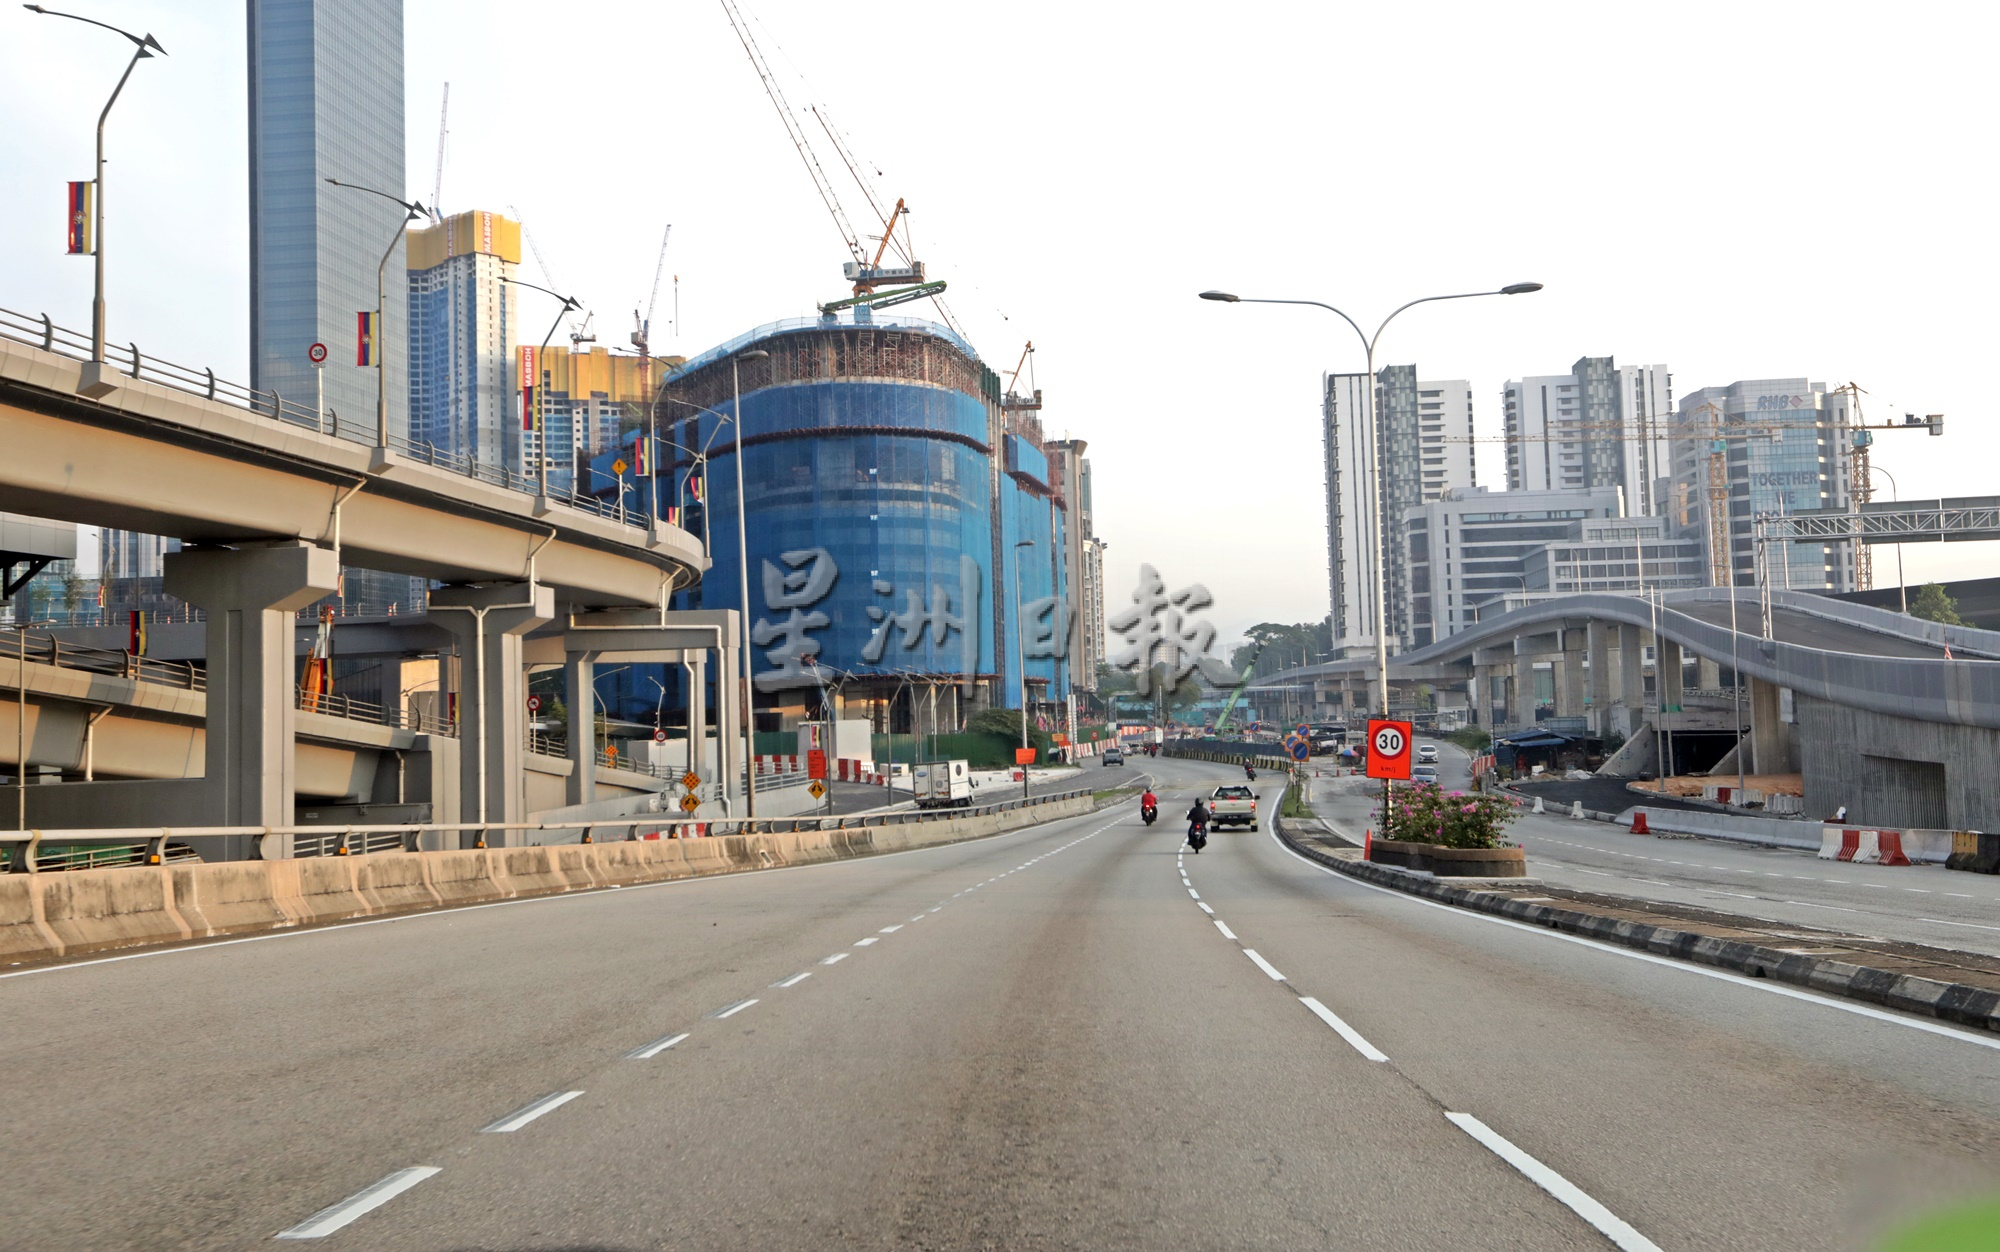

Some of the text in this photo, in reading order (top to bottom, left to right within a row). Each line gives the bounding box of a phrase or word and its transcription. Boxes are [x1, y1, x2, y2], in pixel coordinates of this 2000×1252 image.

[483, 212, 492, 253] MASBOH
[1757, 395, 1789, 410] RHB
[1750, 471, 1818, 486] TOGETHER
[1775, 491, 1796, 504] WE
[1379, 734, 1399, 750] 30
